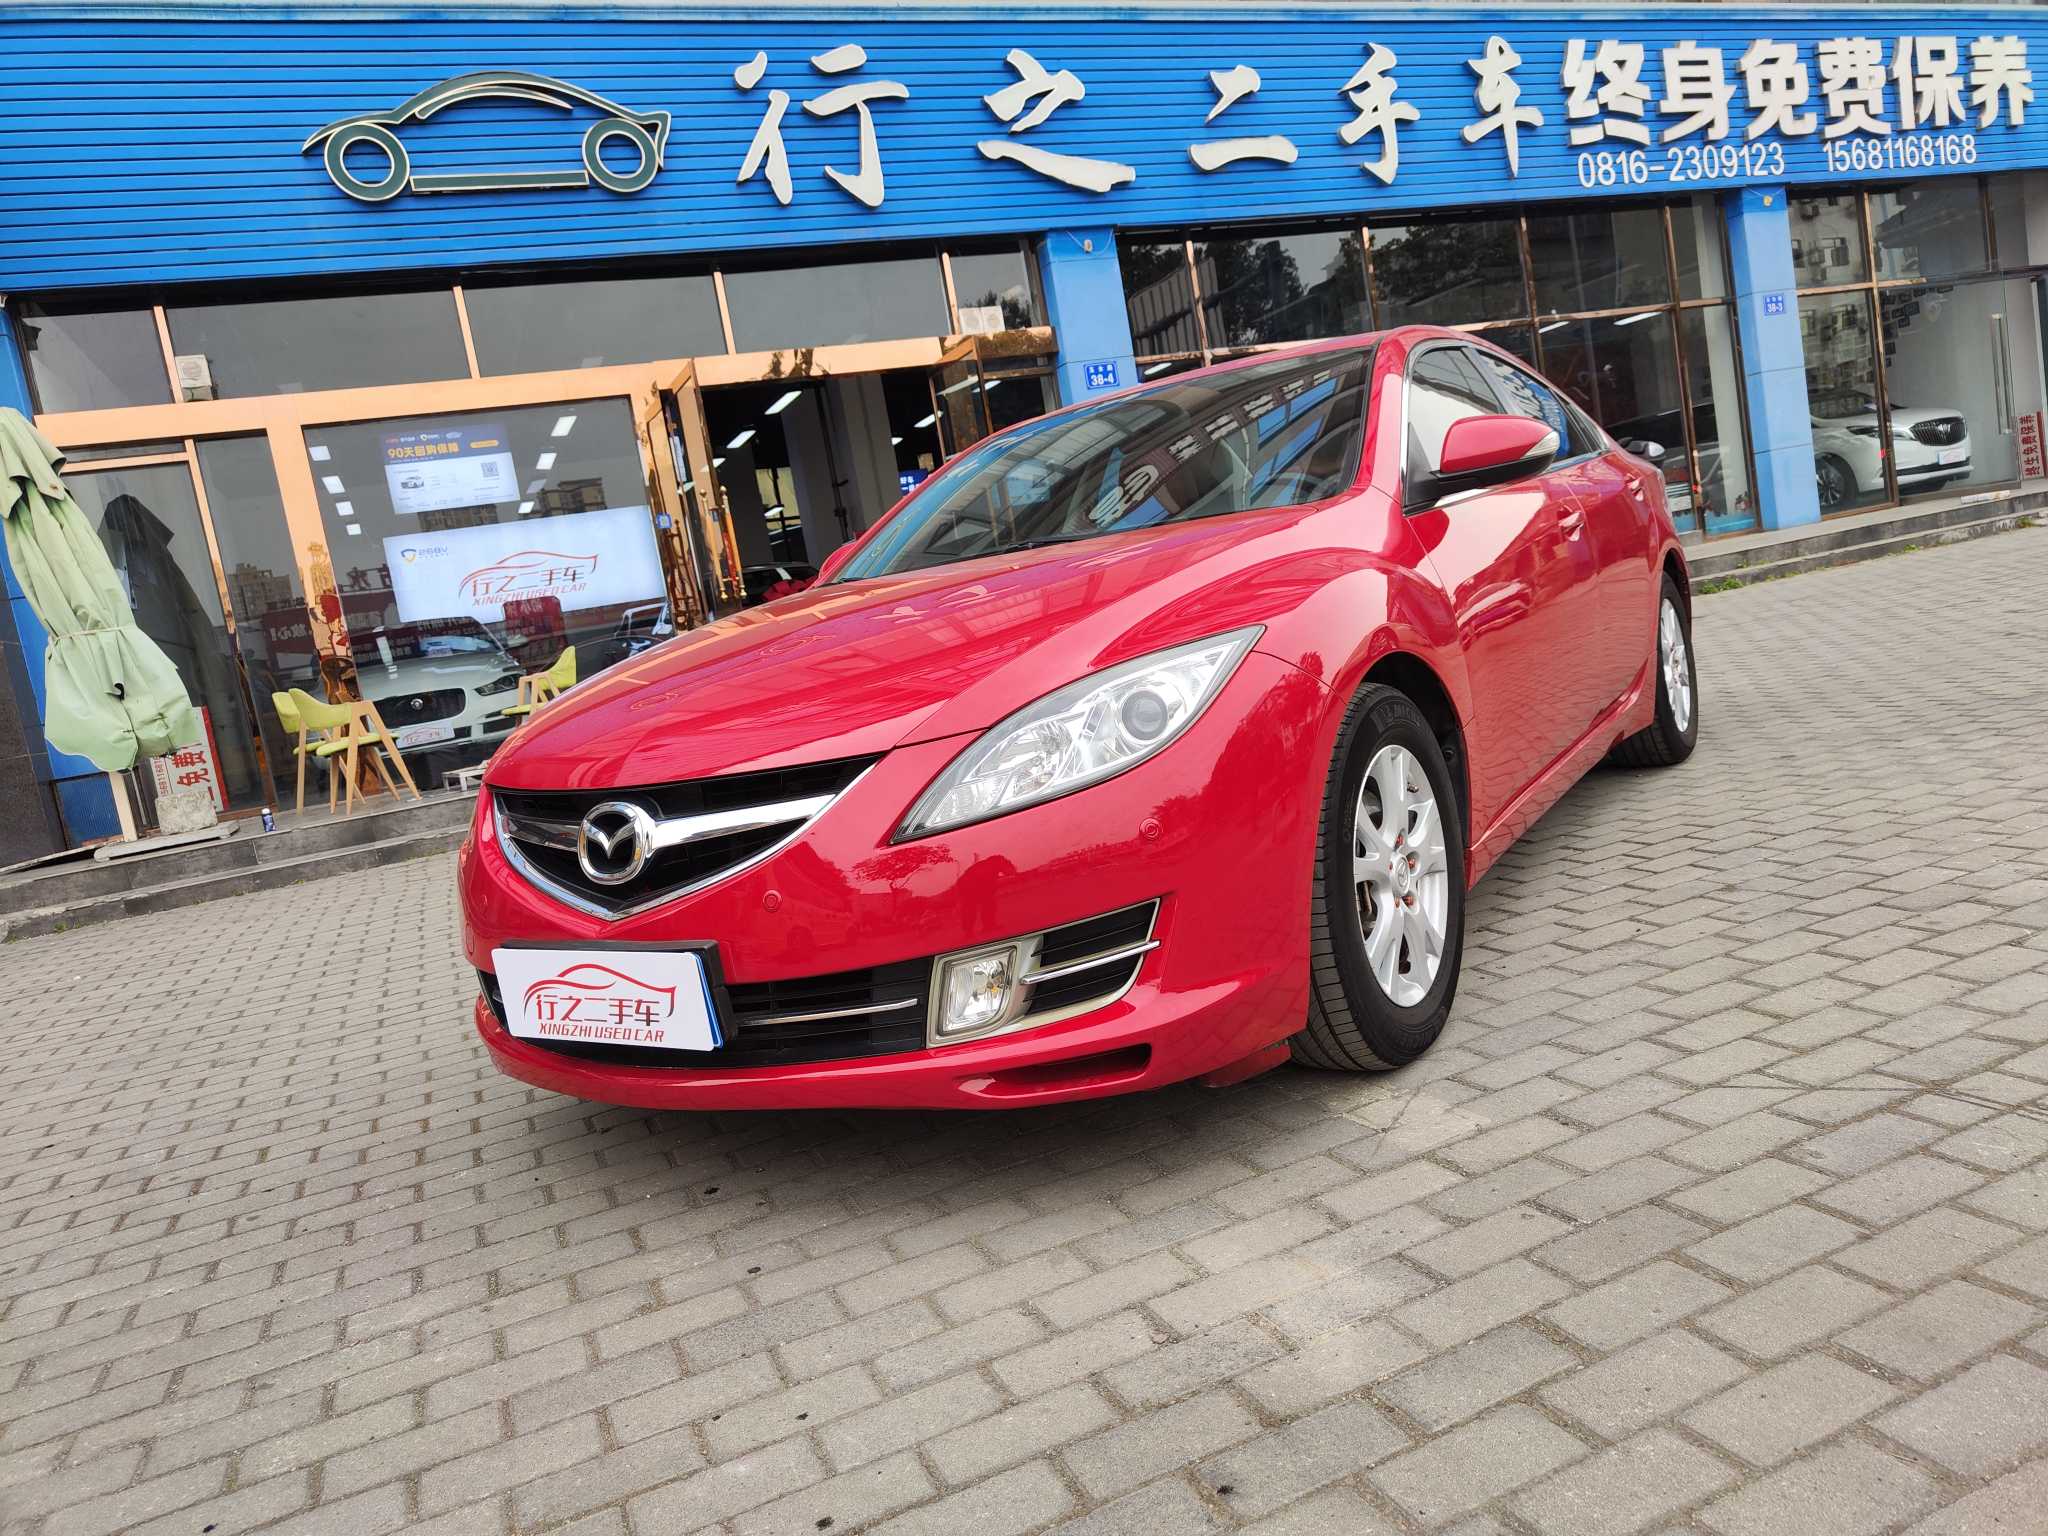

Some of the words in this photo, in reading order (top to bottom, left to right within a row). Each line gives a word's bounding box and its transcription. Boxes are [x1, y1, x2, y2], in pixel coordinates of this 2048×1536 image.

[1563, 35, 2035, 147] 终身免费保养
[733, 35, 1544, 208] 行之二手车
[1577, 142, 1786, 187] 0816-2309123
[1822, 134, 1978, 172] 15681168168
[1090, 372, 1114, 386] 38-4
[471, 565, 585, 598] 行之二手车
[535, 993, 661, 1027] 行之二手车
[538, 1022, 592, 1039] XINGZHI
[593, 1026, 633, 1041] USED
[634, 1029, 665, 1043] CAR
